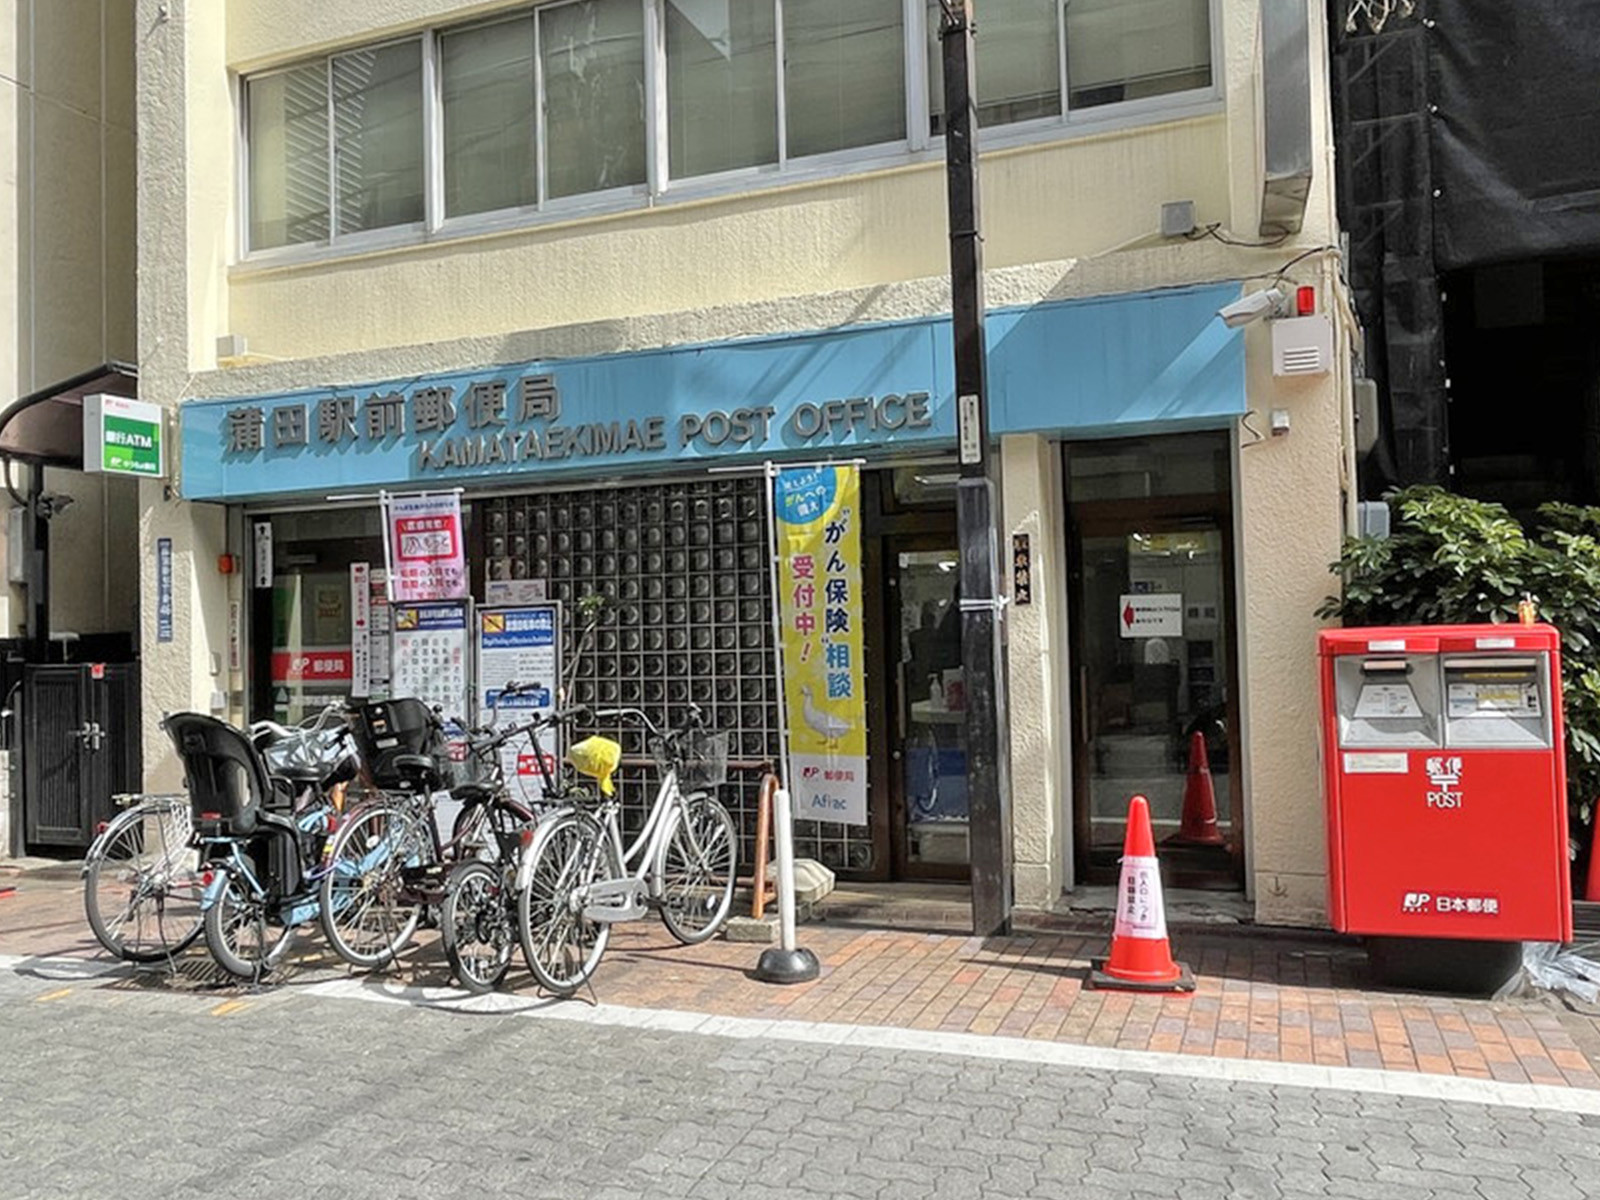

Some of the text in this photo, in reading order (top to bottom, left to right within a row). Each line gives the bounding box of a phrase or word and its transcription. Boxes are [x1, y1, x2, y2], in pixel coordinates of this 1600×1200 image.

[226, 373, 562, 452] 蒲田駅前郵便局
[417, 415, 666, 469] KAMATAEKIMAE
[679, 406, 775, 449] POST
[793, 392, 932, 438] OFFICE
[1426, 792, 1463, 808] POST
[1436, 896, 1499, 914] 日本郵便
